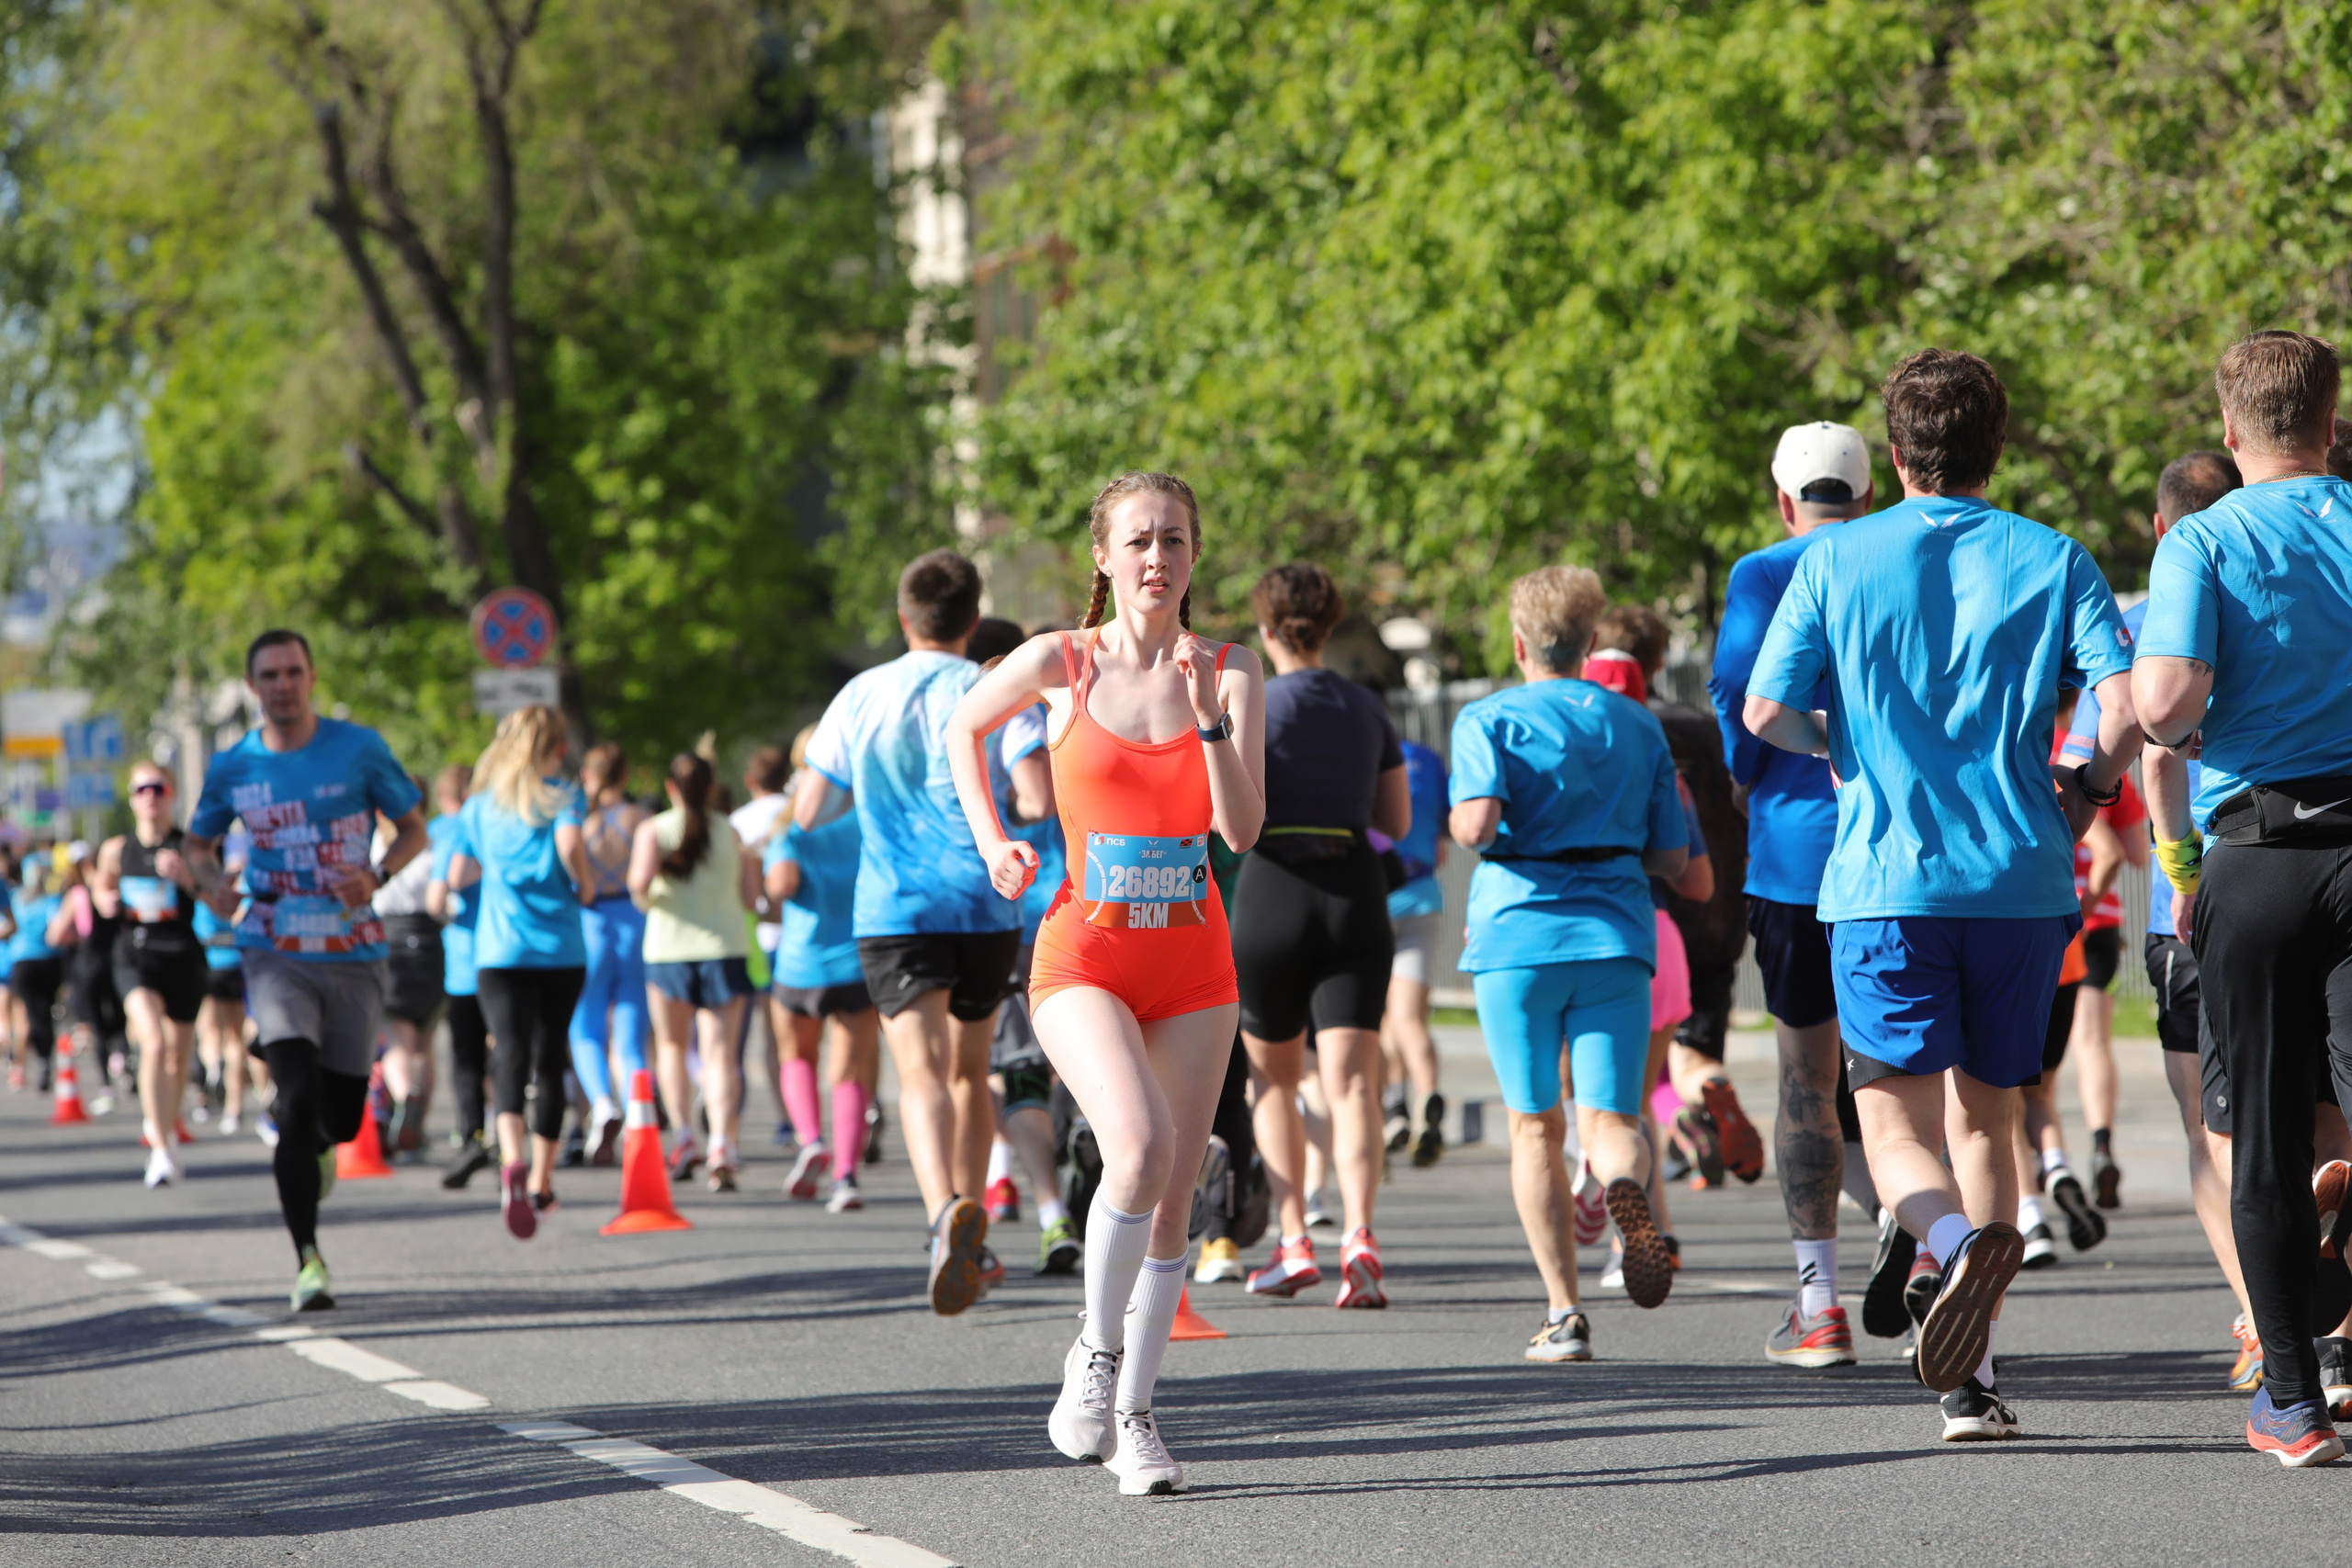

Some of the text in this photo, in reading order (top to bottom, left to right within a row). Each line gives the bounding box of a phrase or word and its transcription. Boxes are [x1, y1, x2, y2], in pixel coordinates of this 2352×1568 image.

[1106, 838, 1125, 846] ПСБ
[1108, 864, 1191, 898] 26892
[1128, 902, 1170, 929] 5KM
